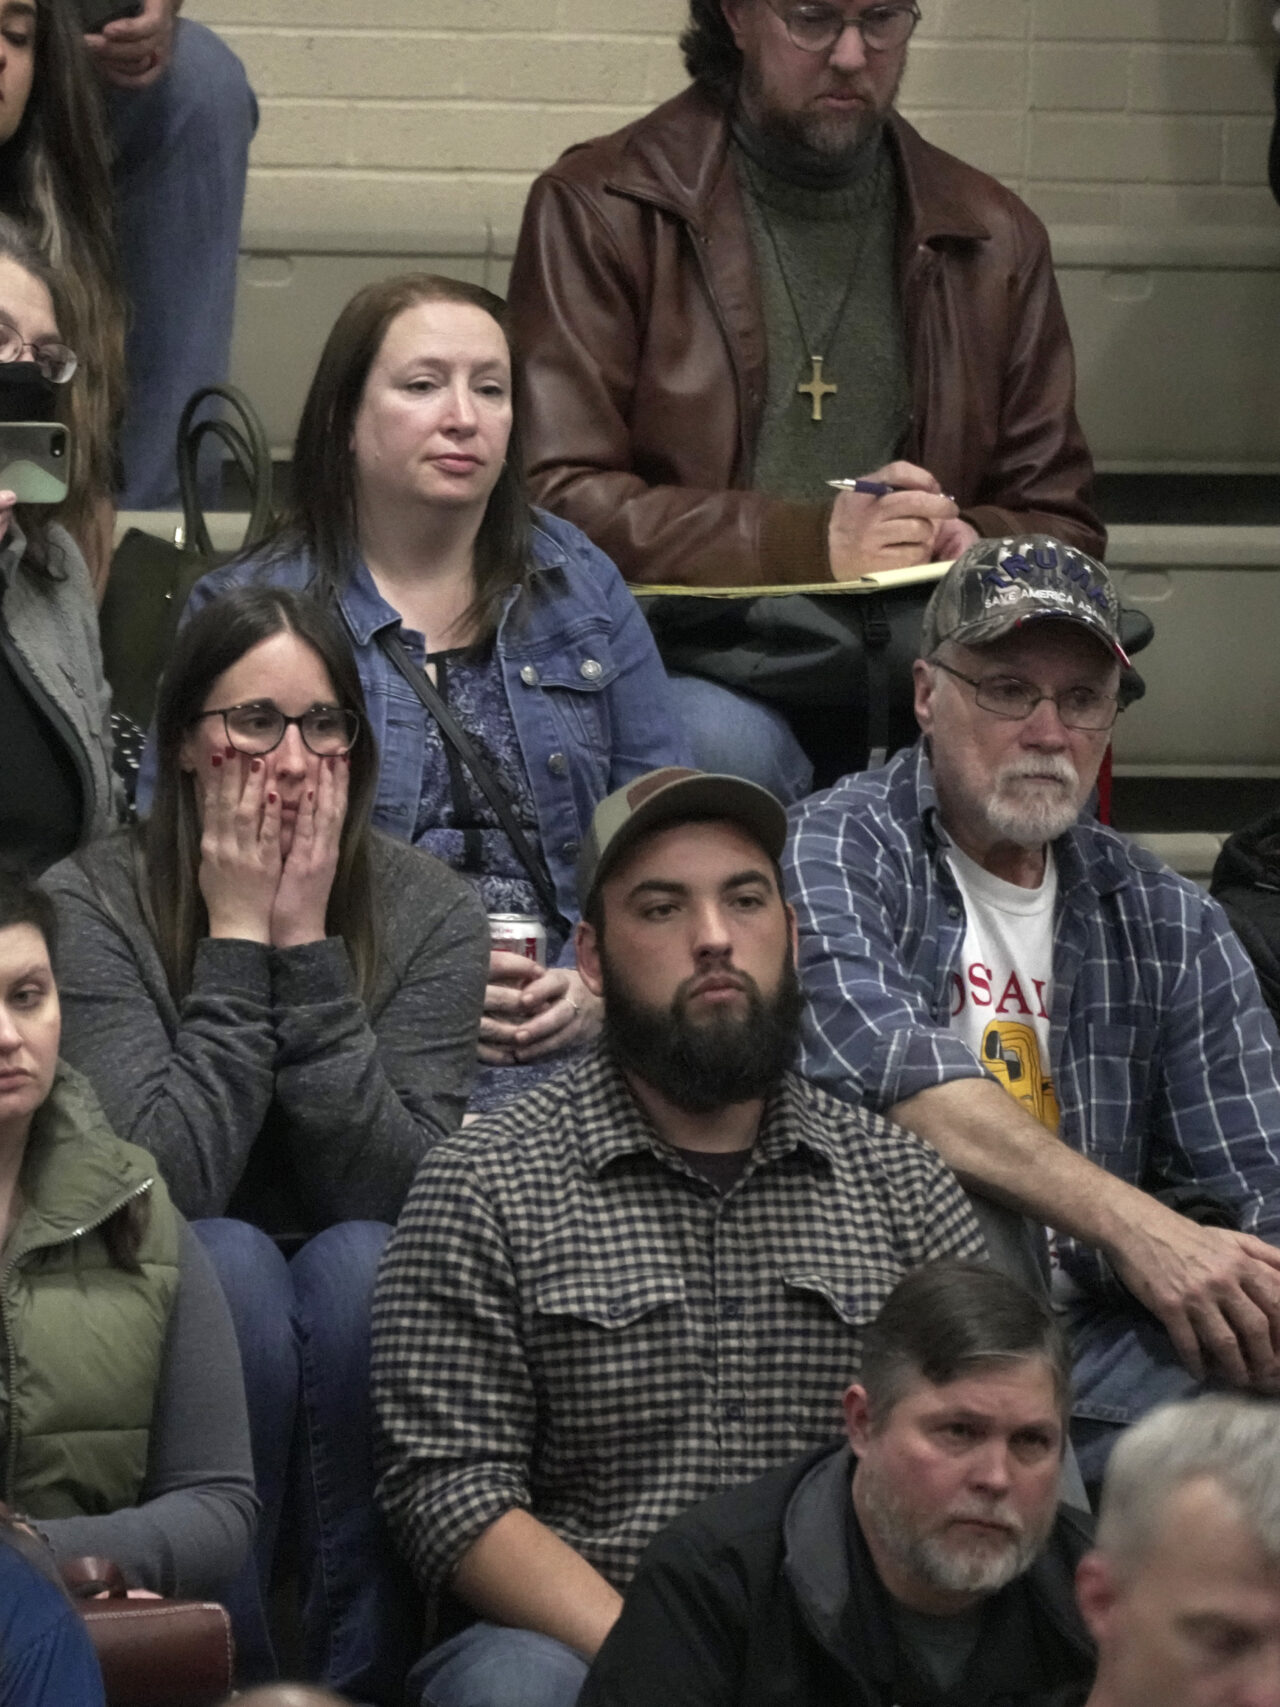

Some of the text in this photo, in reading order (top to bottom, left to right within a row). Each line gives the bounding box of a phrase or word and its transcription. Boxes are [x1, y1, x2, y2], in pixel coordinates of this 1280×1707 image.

[982, 548, 1108, 609] TRUMP
[984, 588, 1107, 628] SAVE AMERICA AGA
